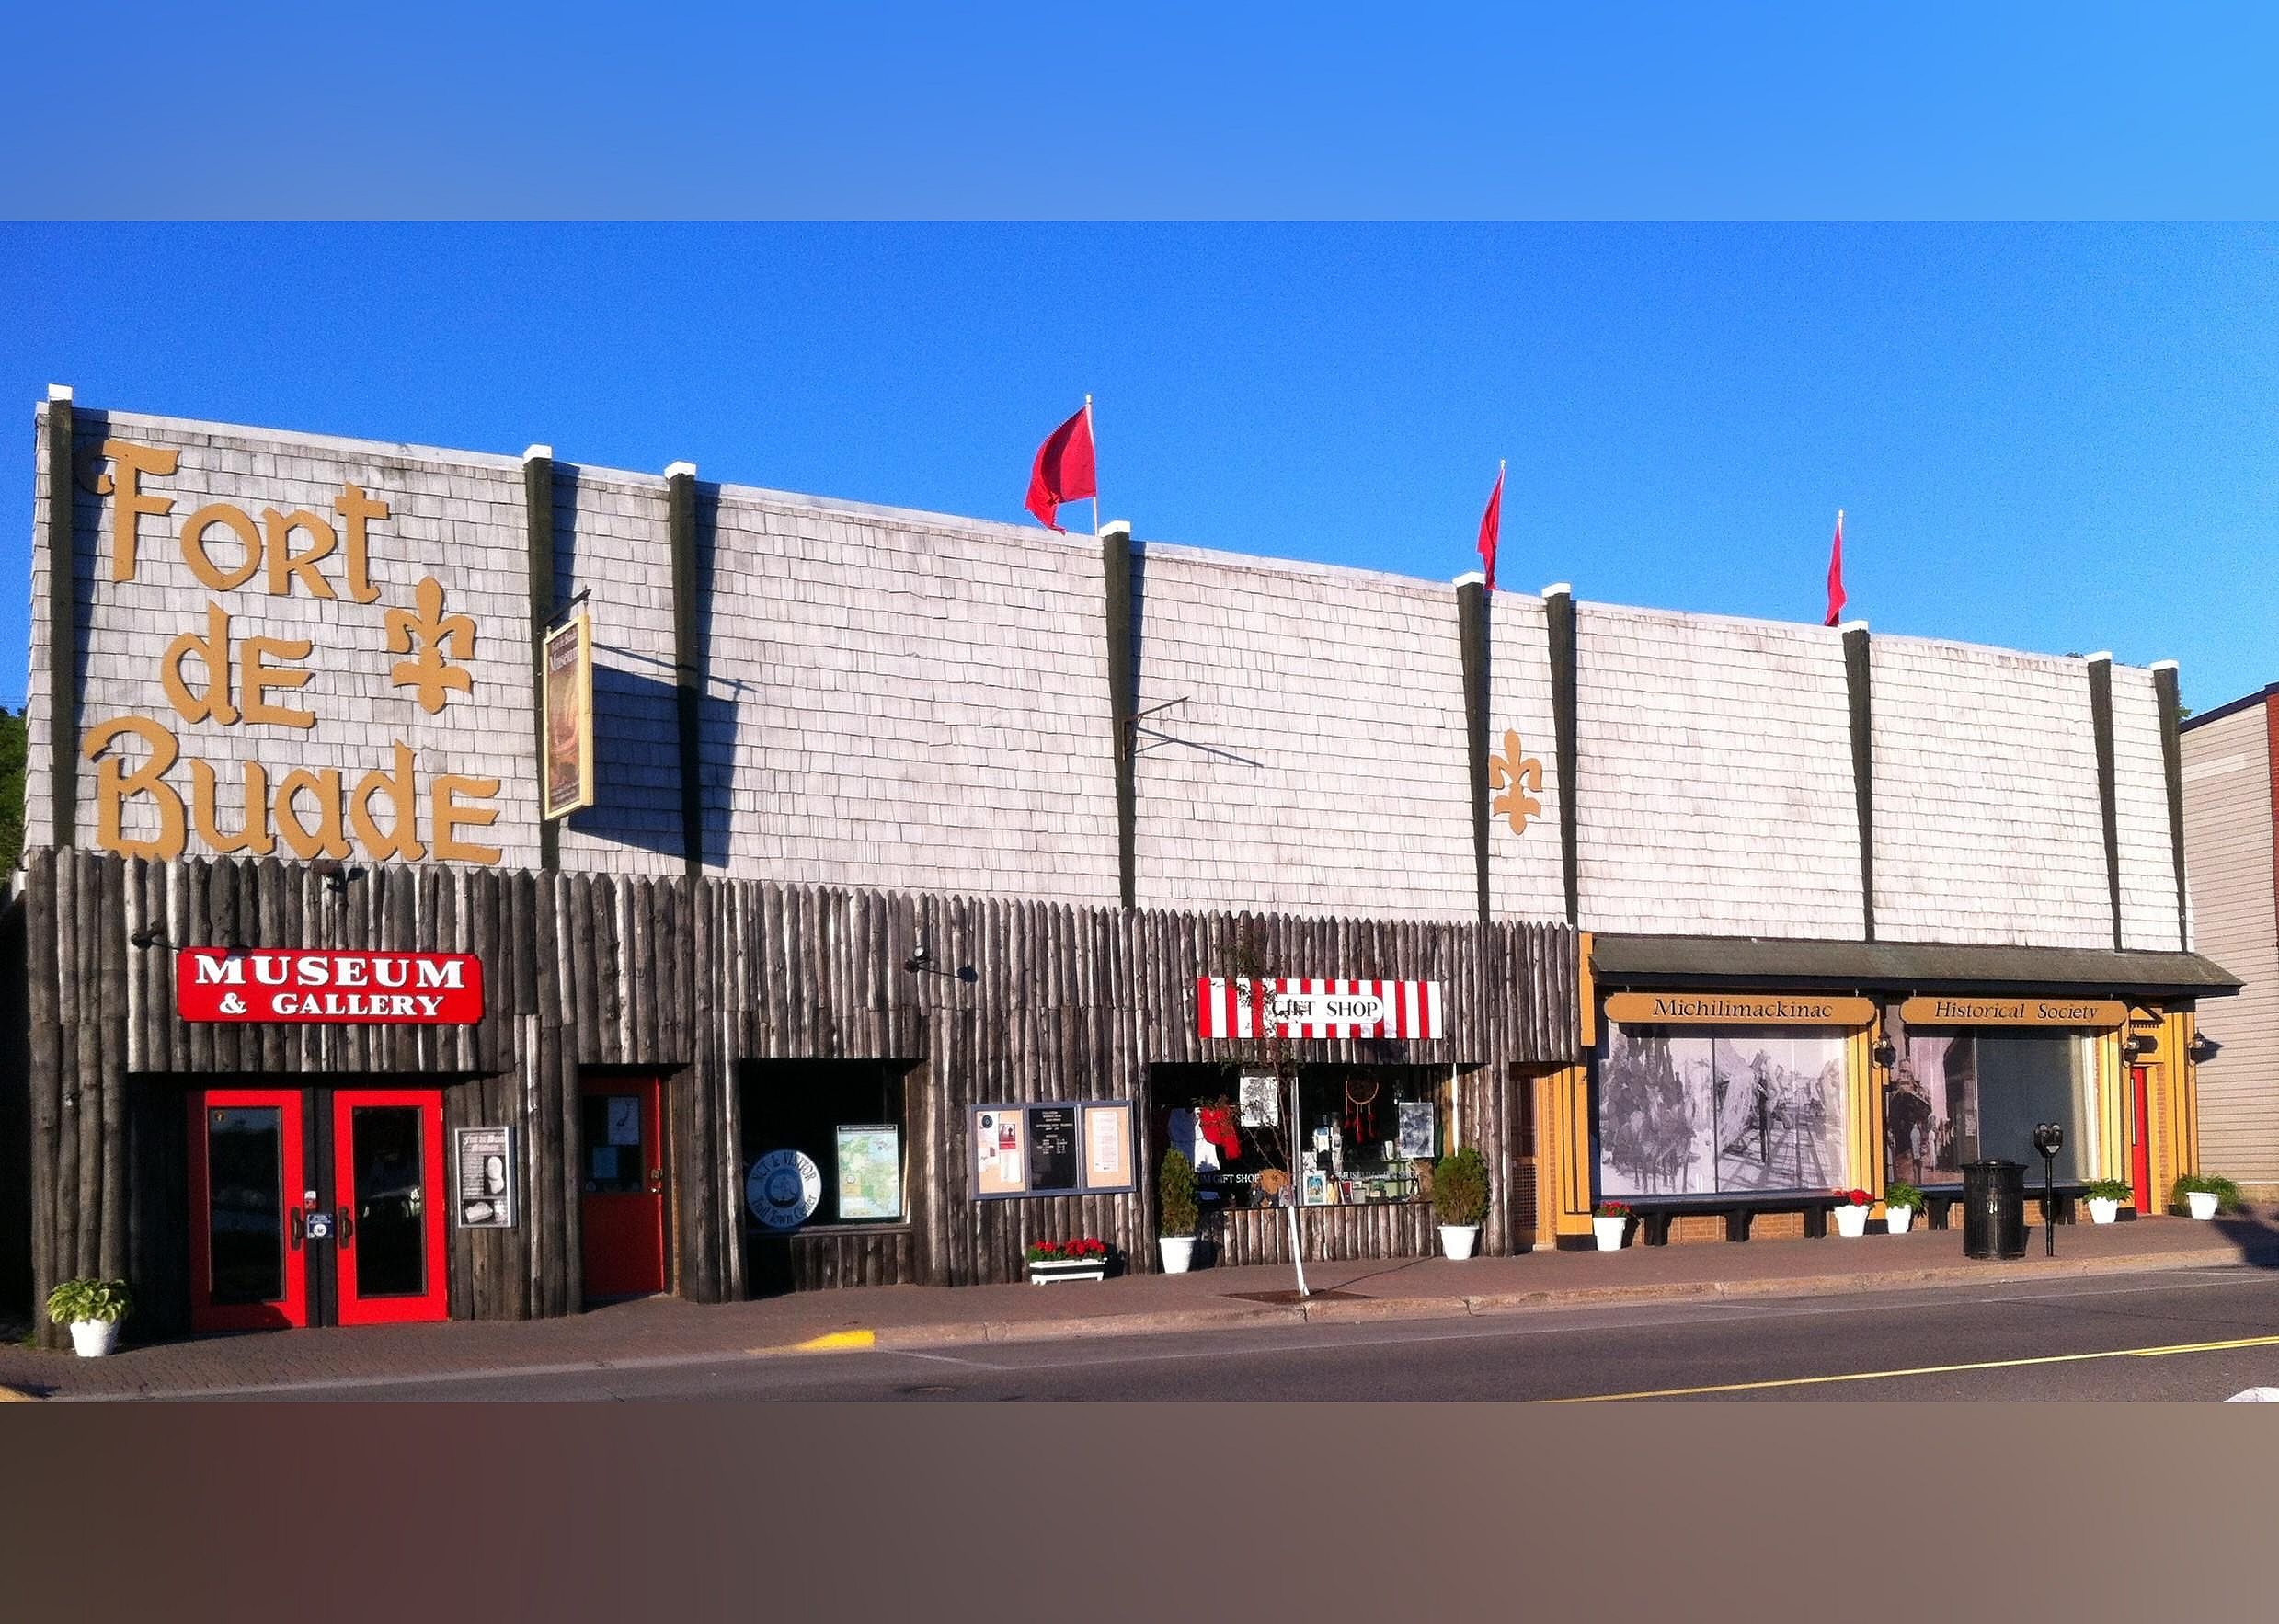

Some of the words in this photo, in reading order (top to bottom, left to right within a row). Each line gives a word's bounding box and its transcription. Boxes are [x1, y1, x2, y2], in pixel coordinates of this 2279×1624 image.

[194, 954, 465, 989] MUSEUM
[219, 992, 247, 1014] &
[271, 992, 444, 1016] GALLERY
[1272, 1000, 1316, 1016] GIFT
[1326, 1001, 1379, 1017] SHOP
[1653, 998, 1834, 1018] Michilimackinac
[1934, 1001, 2025, 1018] Historical
[2037, 1002, 2100, 1023] Society
[783, 1151, 817, 1183] VISITOR
[1214, 1173, 1234, 1184] GIFT
